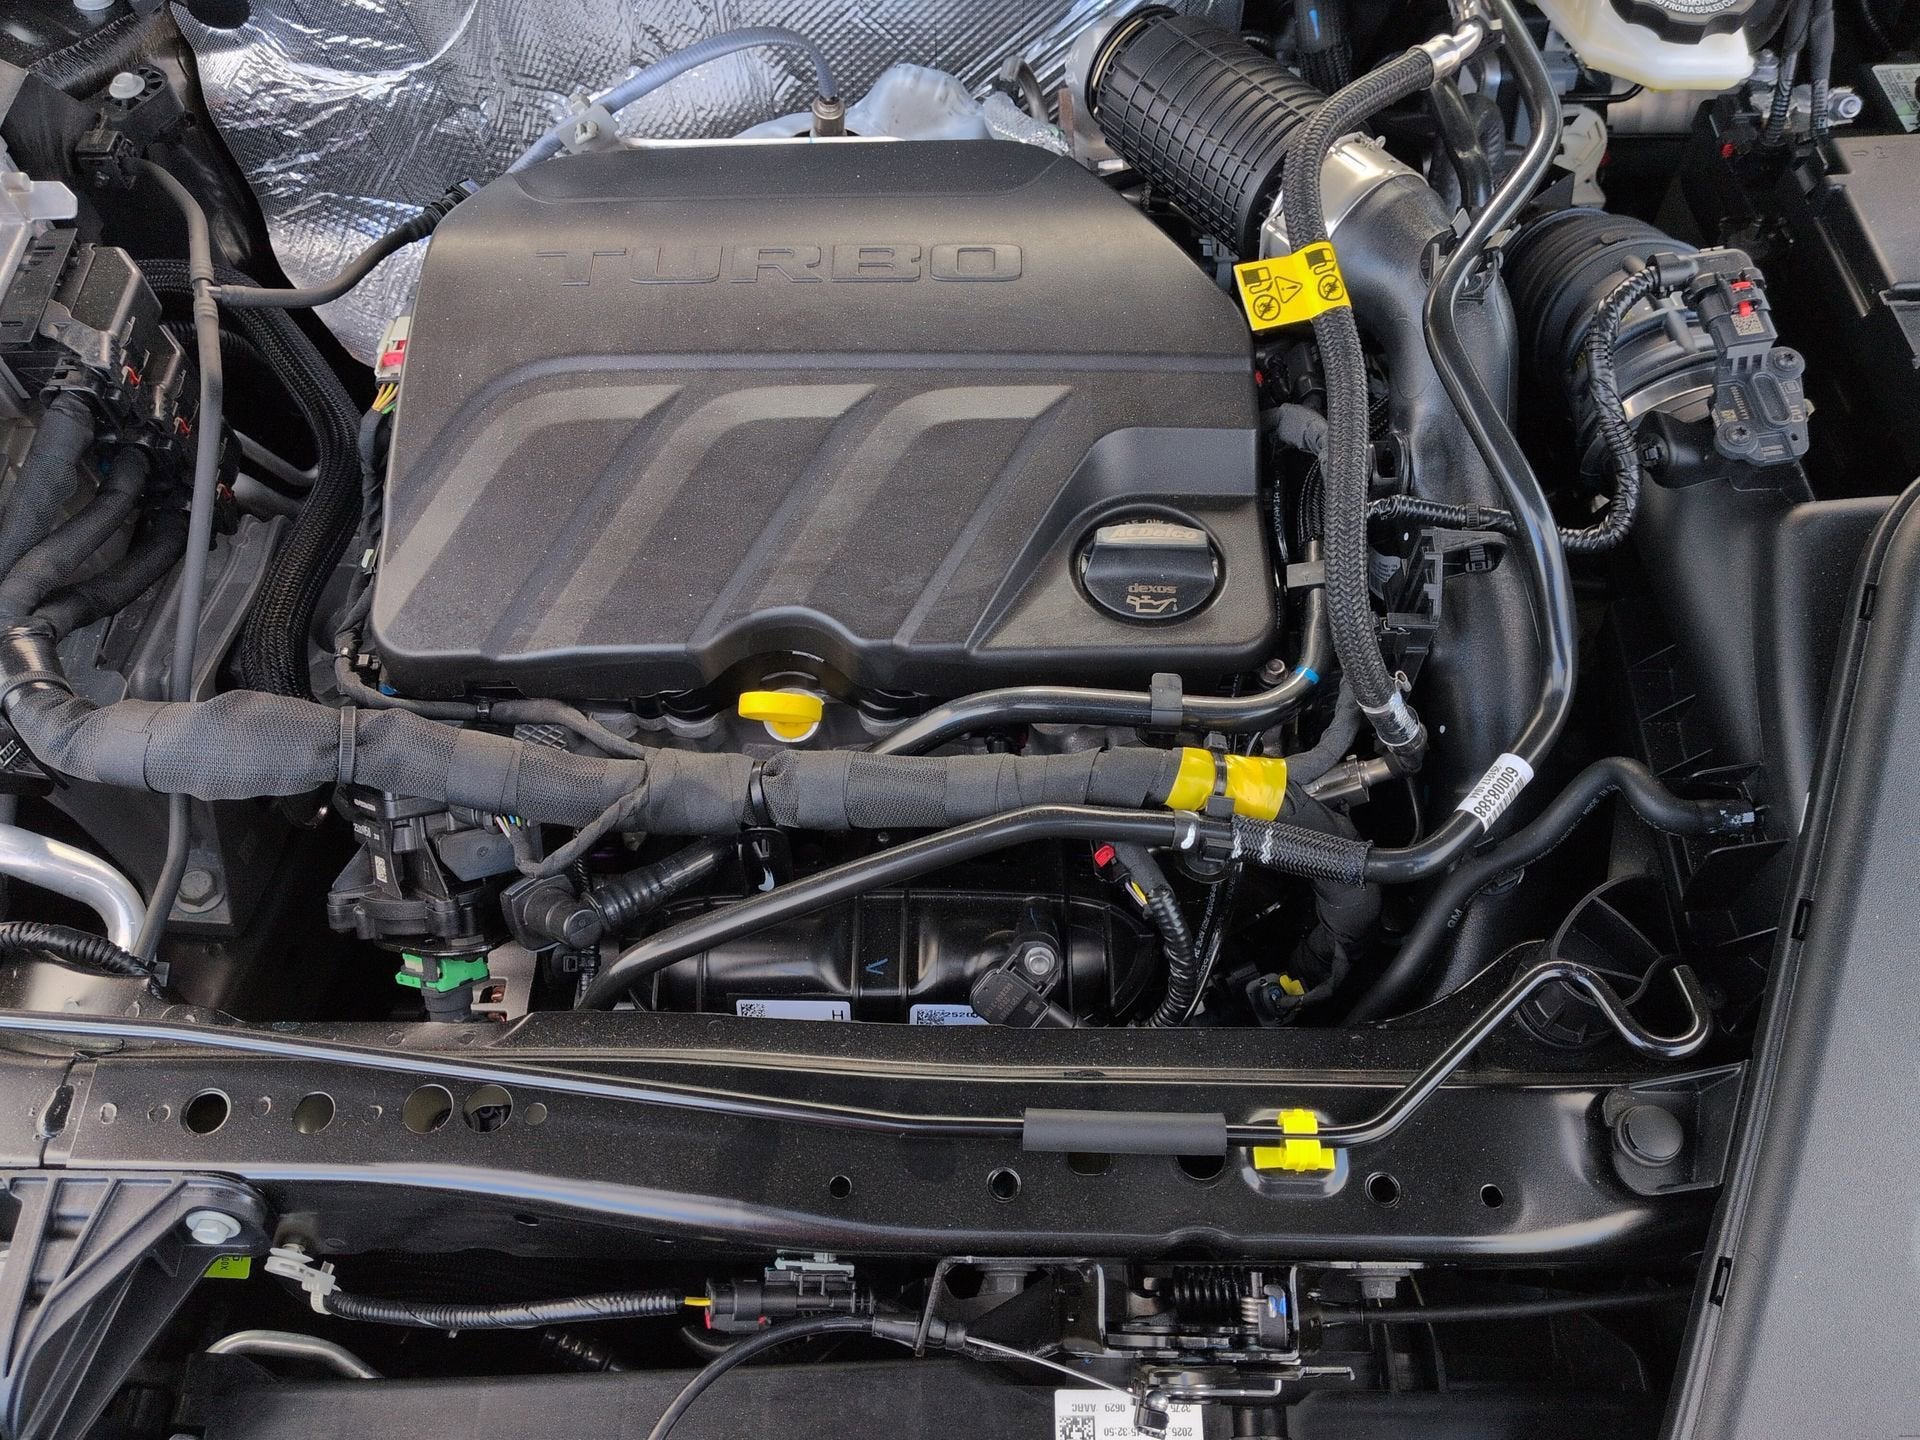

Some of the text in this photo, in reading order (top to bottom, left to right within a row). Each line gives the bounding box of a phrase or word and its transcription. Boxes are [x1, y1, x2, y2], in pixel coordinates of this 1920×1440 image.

[1664, 1, 1687, 13] FROM
[1695, 3, 1724, 14] SEALED
[535, 243, 1025, 286] TURBO
[1110, 527, 1199, 539] ACDelco
[1127, 583, 1177, 594] dexos
[1472, 765, 1519, 819] 60008388
[831, 1009, 844, 1021] H
